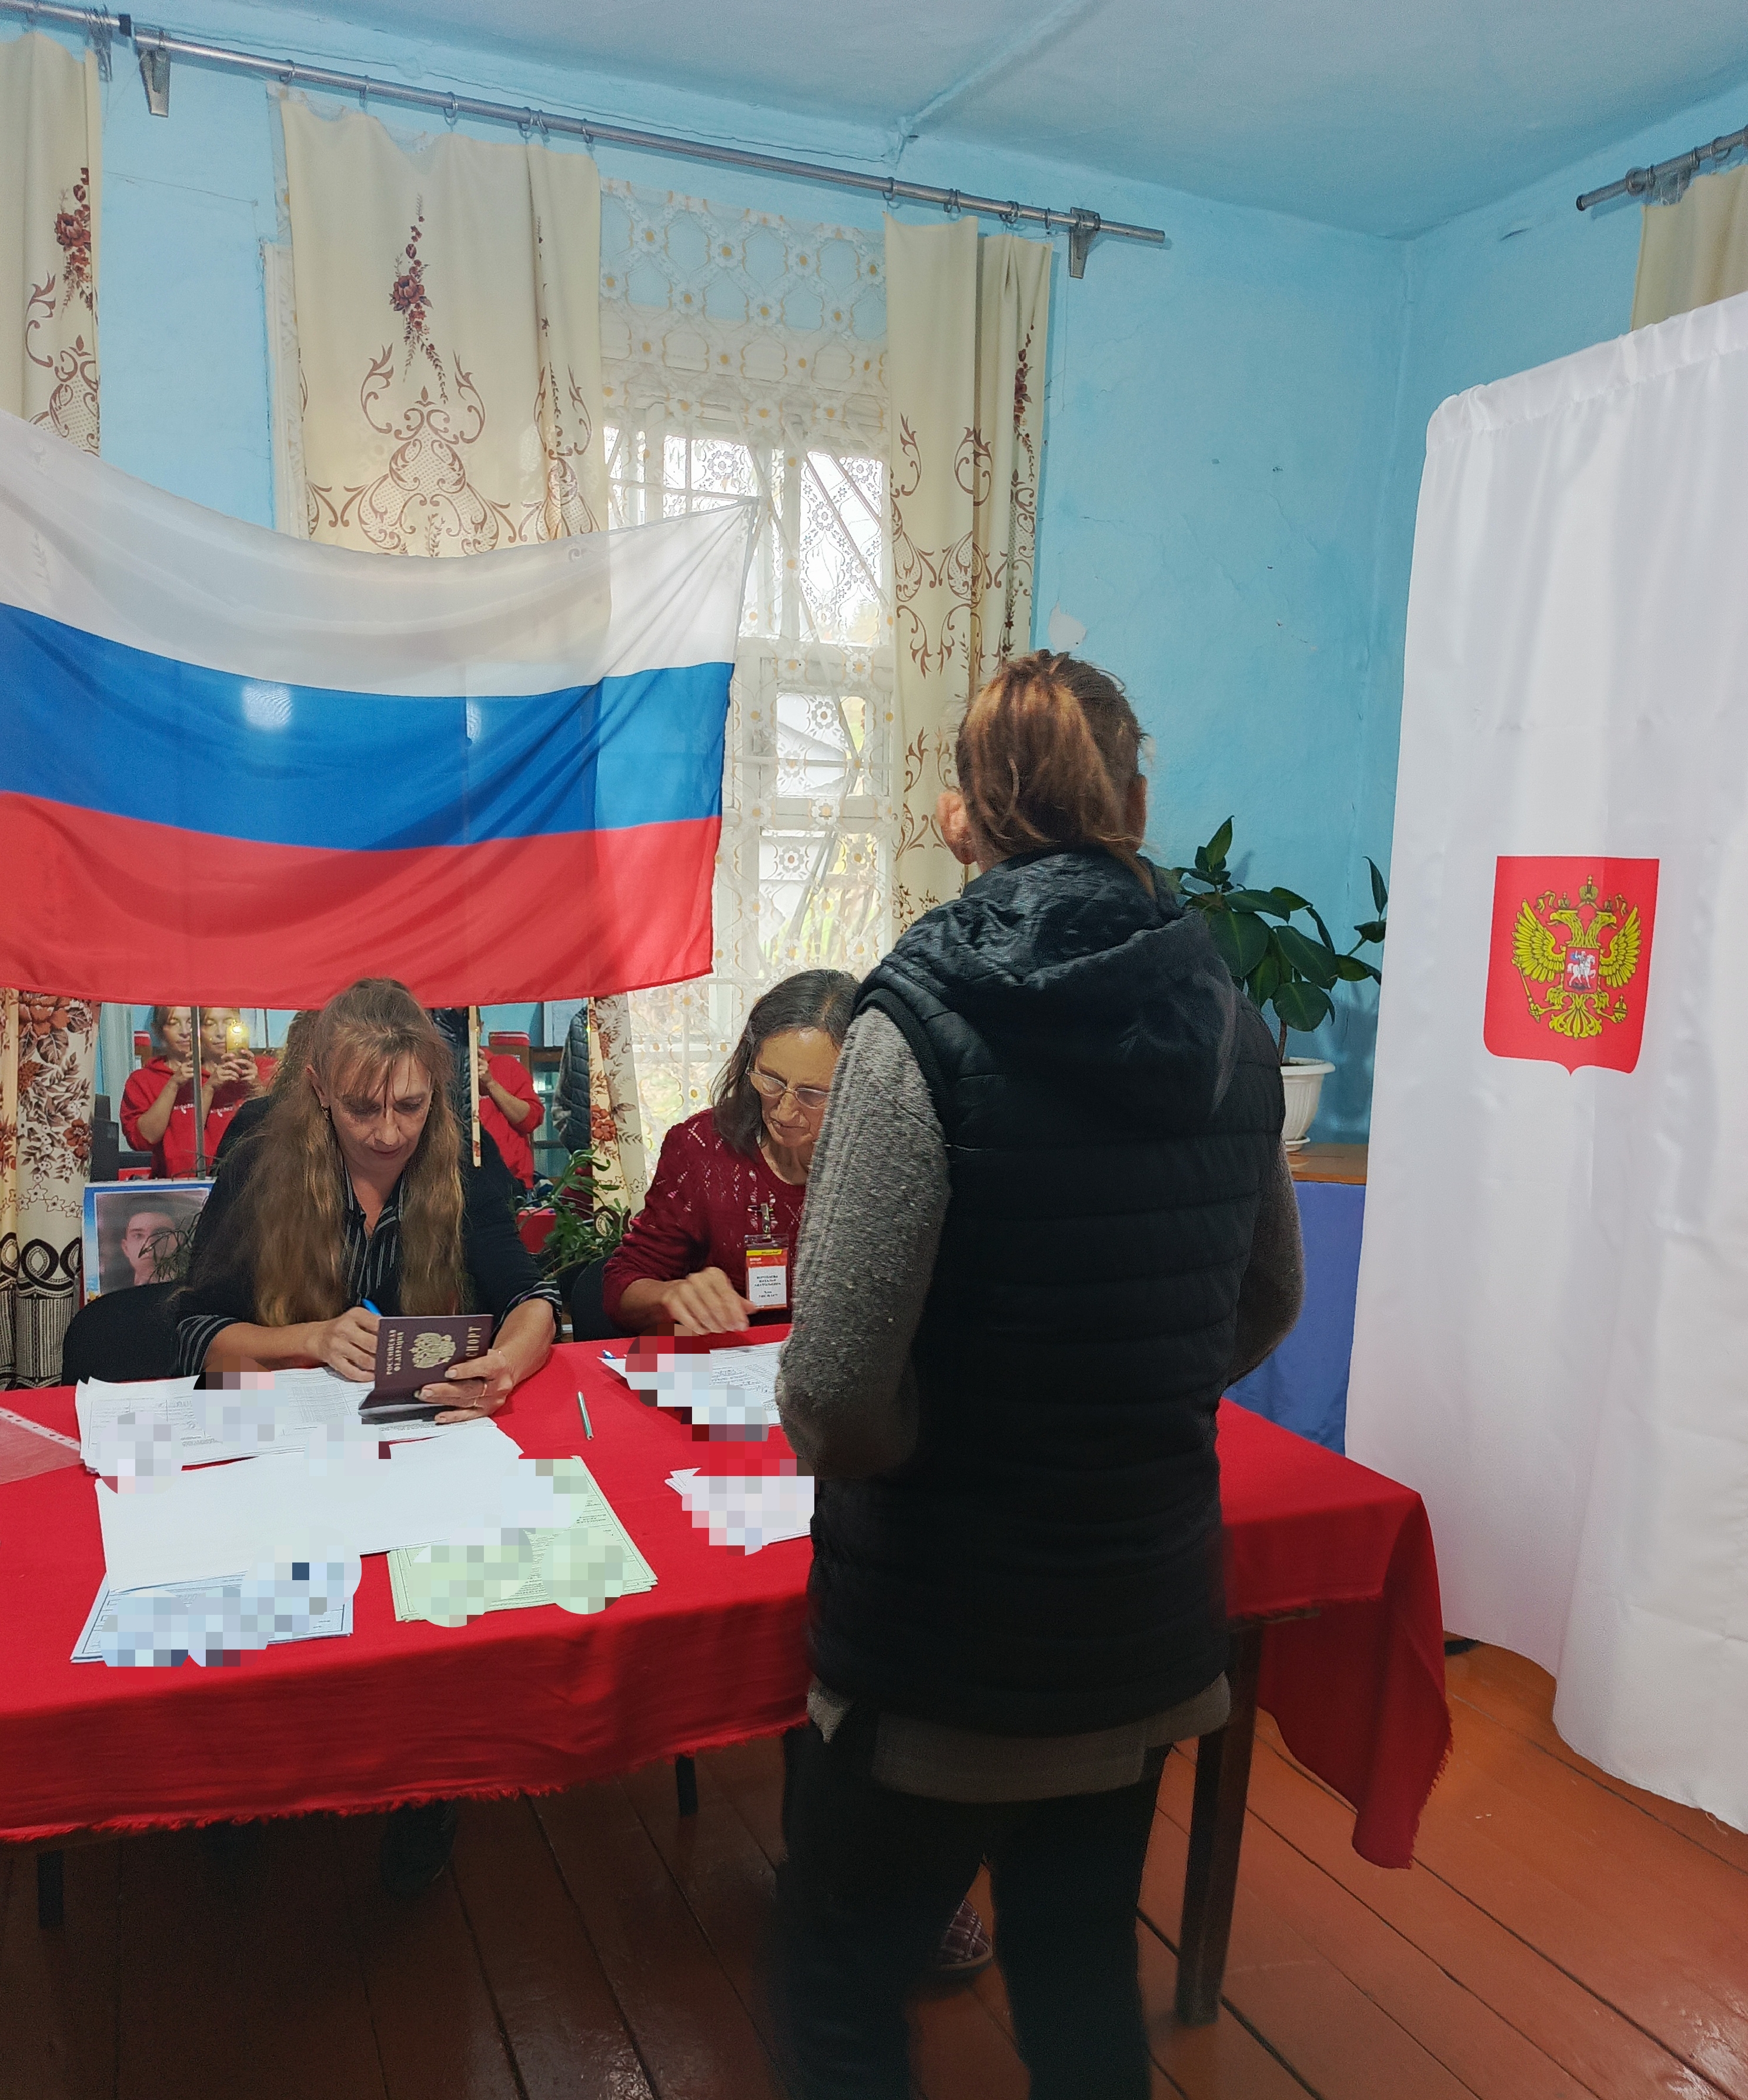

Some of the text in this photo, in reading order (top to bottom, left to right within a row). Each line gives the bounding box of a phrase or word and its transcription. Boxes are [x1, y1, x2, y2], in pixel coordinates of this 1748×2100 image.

[386, 1329, 397, 1375] РОССИЙСКАЯ
[394, 1331, 405, 1371] ФЕДЕРАЦИЯ
[465, 1326, 482, 1357] СПОРТ
